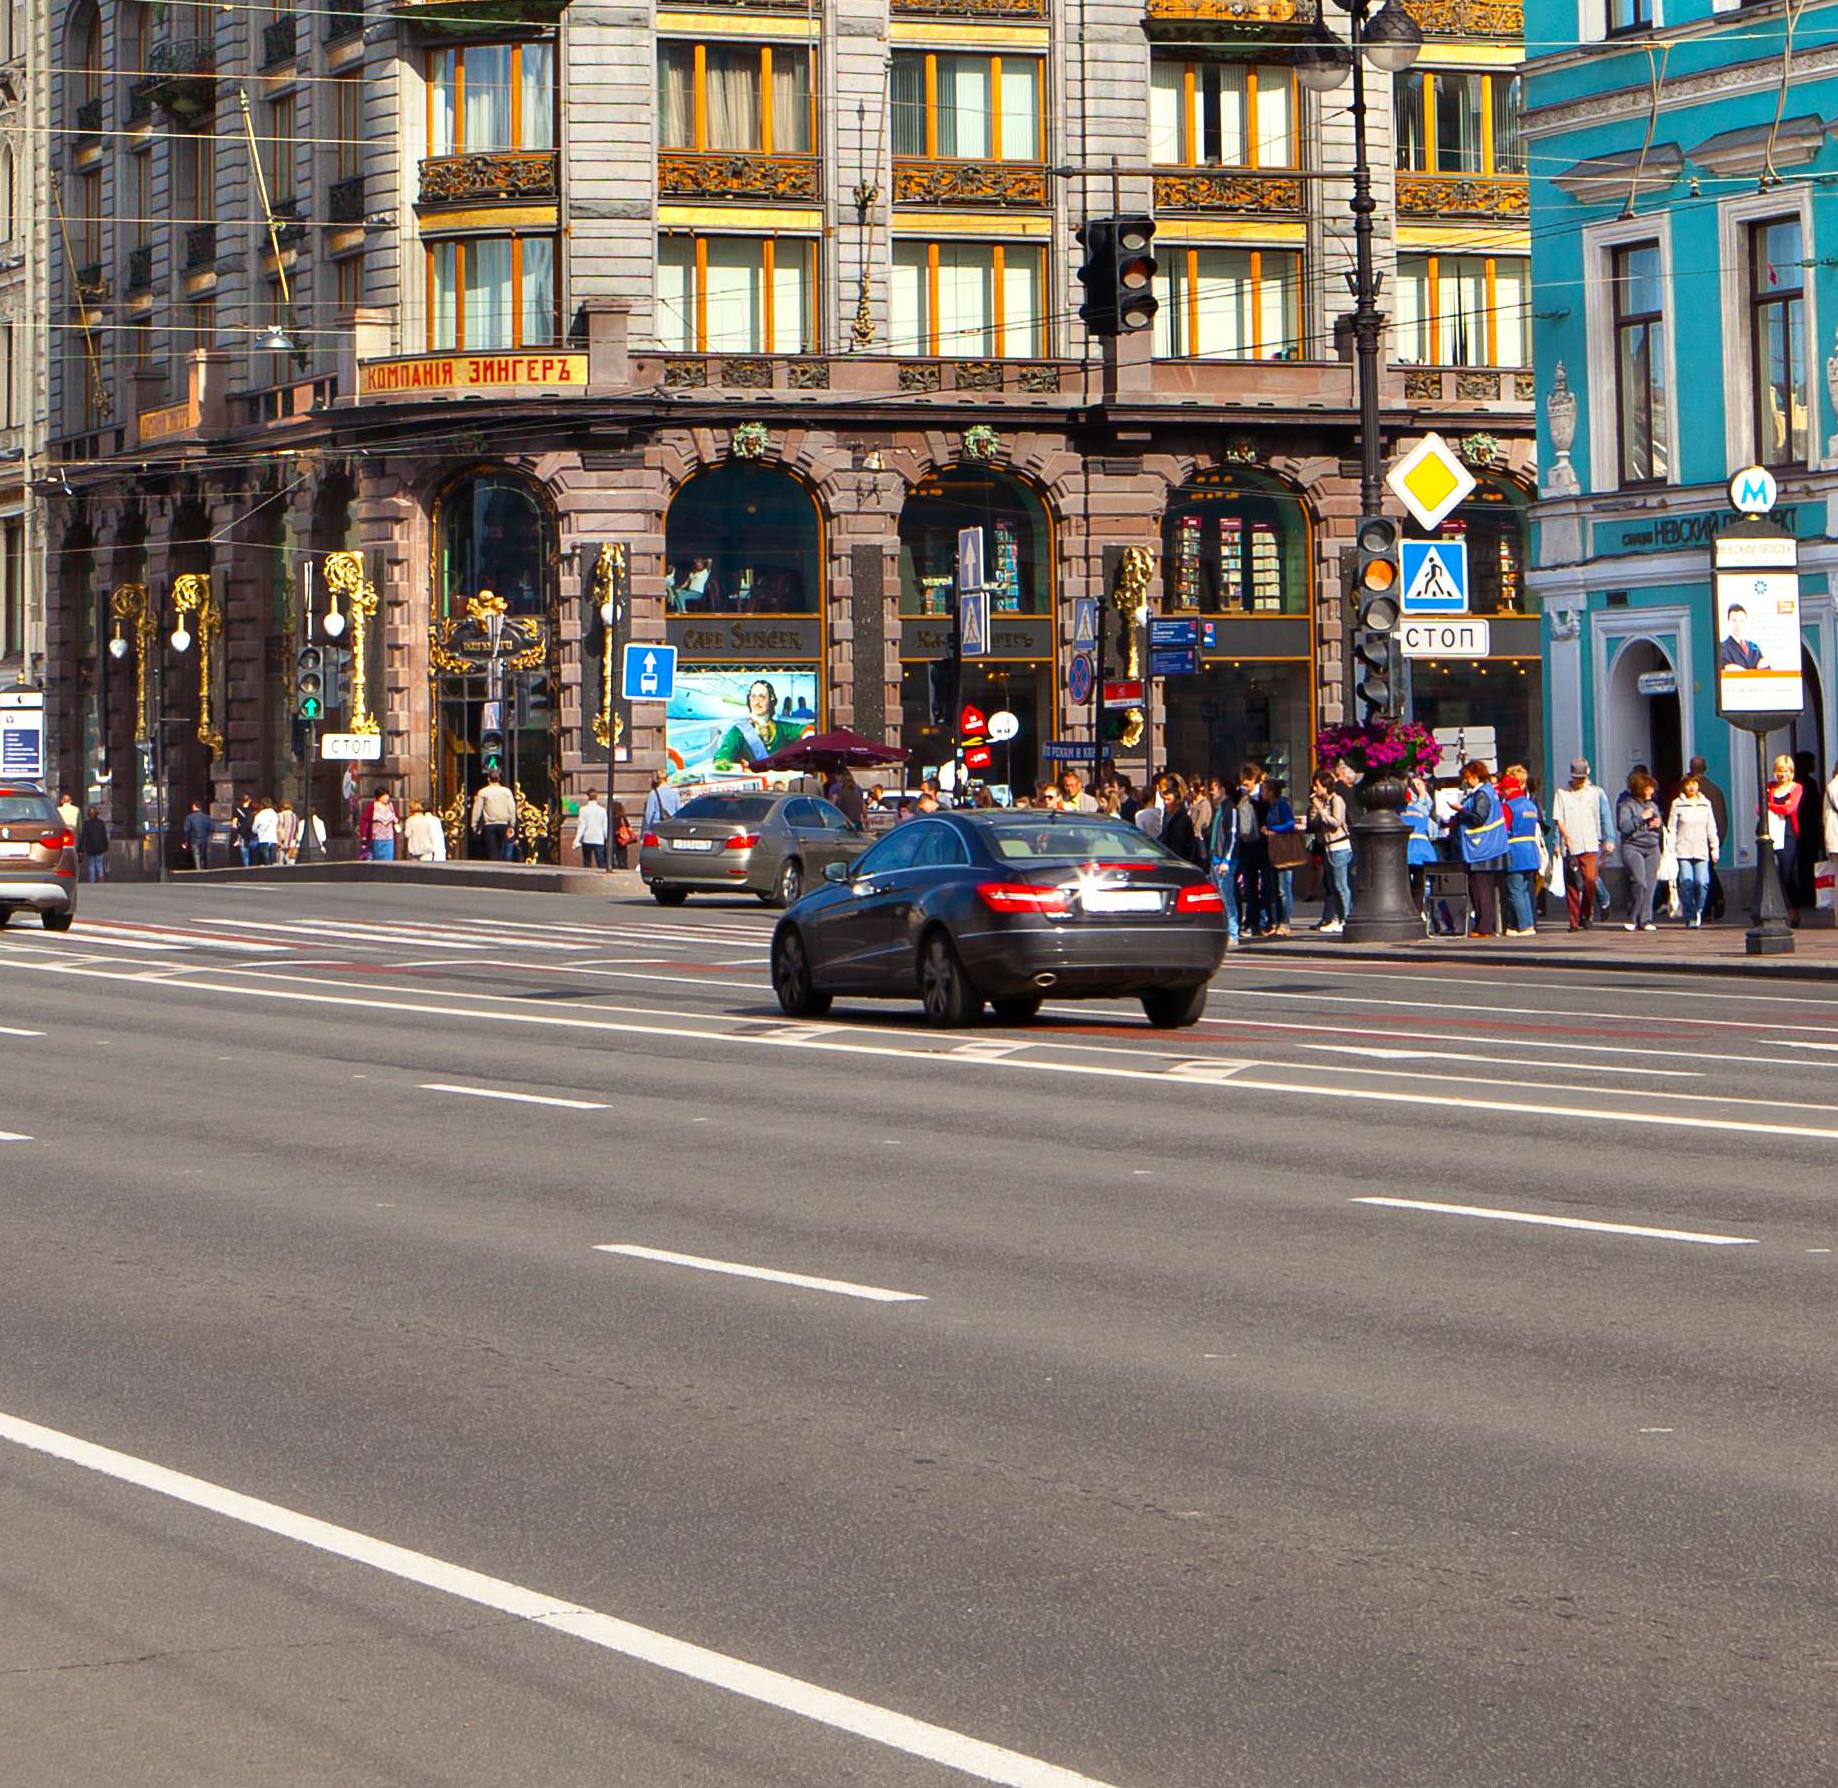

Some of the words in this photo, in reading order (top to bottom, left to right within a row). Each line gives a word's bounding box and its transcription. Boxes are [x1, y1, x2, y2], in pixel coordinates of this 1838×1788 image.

[368, 361, 454, 390] КОМПАНІЯ
[468, 359, 571, 383] ЗИНГЕРЪ
[1653, 511, 1719, 547] НЕВСКИЙ
[1405, 628, 1474, 648] СТОП
[331, 739, 371, 754] СТОП
